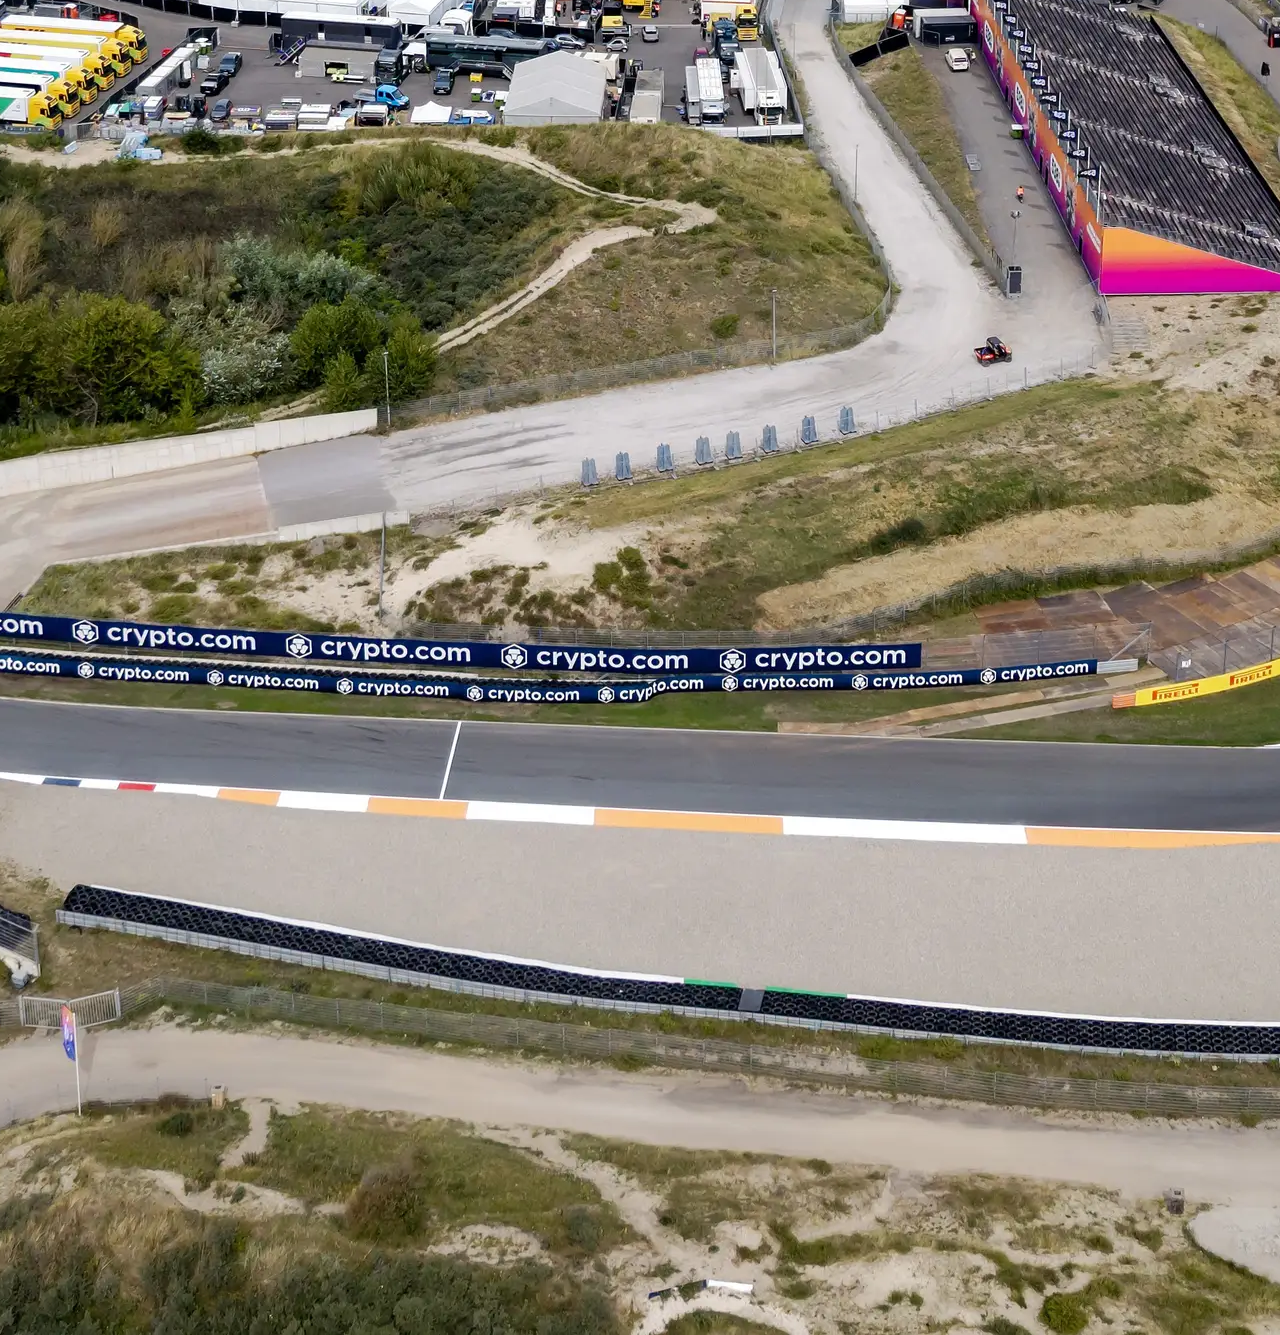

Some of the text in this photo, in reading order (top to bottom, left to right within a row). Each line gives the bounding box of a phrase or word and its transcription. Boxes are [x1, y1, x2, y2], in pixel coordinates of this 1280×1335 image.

[107, 626, 256, 652] crypto.com
[320, 636, 472, 664] crypto.com
[536, 645, 689, 672] crypto.com
[754, 644, 907, 670] crypto.com
[98, 663, 189, 684] crypto.com
[228, 670, 319, 690] crypto.com
[873, 670, 964, 690] crypto.com
[1000, 662, 1090, 681] crypto.com
[1229, 665, 1272, 686] PIRELLI
[356, 678, 450, 698] crypto.com
[619, 675, 704, 702] crypto.com
[742, 673, 834, 692] crypto.com
[1152, 682, 1200, 701] PIRELLI
[488, 685, 580, 703] crypto.com
